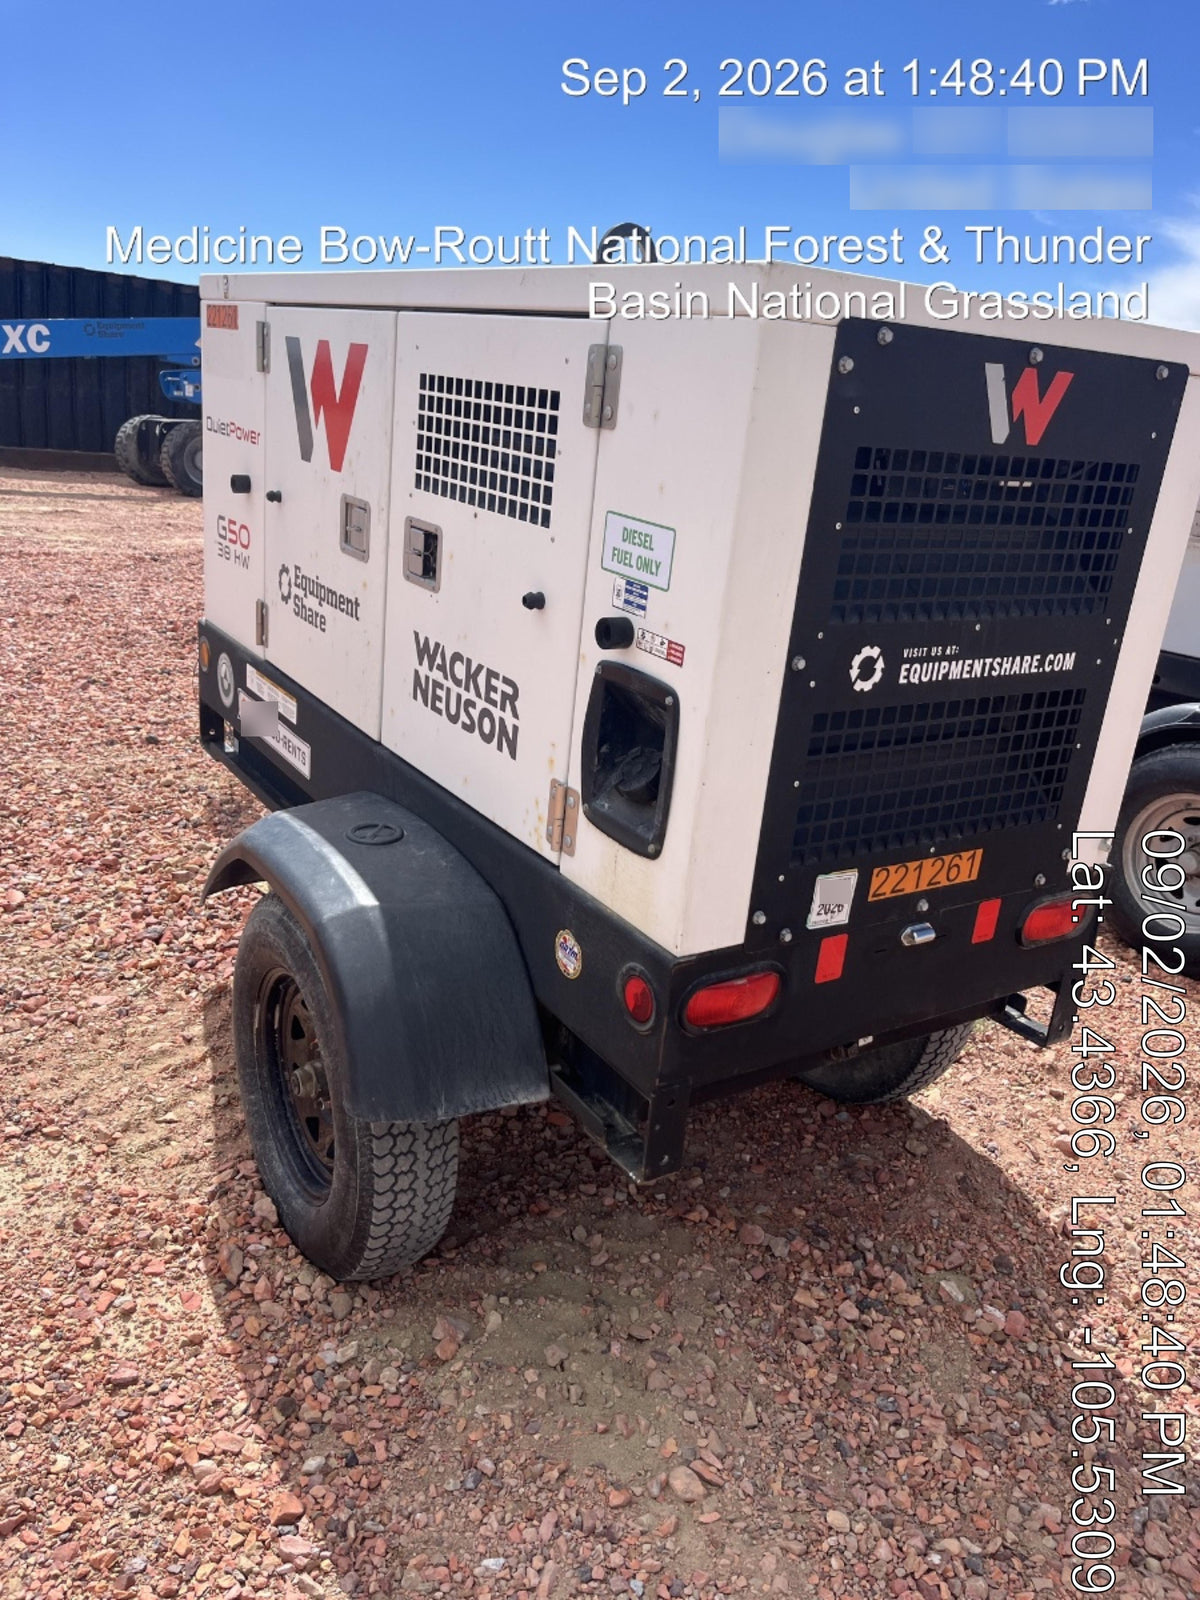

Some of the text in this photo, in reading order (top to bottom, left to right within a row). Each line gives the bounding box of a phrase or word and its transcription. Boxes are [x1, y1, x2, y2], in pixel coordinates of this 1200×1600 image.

[1, 323, 52, 355] XC
[216, 514, 250, 550] G50
[622, 526, 655, 551] DIESEL
[611, 546, 662, 577] FUEL ONLY
[293, 564, 361, 621] Equipment
[293, 593, 327, 633] Share
[898, 652, 1077, 685] EQUIPMENTSHARE.COM
[903, 645, 960, 659] VISIT US AT:
[413, 630, 520, 721] WACKER
[412, 668, 520, 761] NEUSON
[870, 850, 978, 899] 221261
